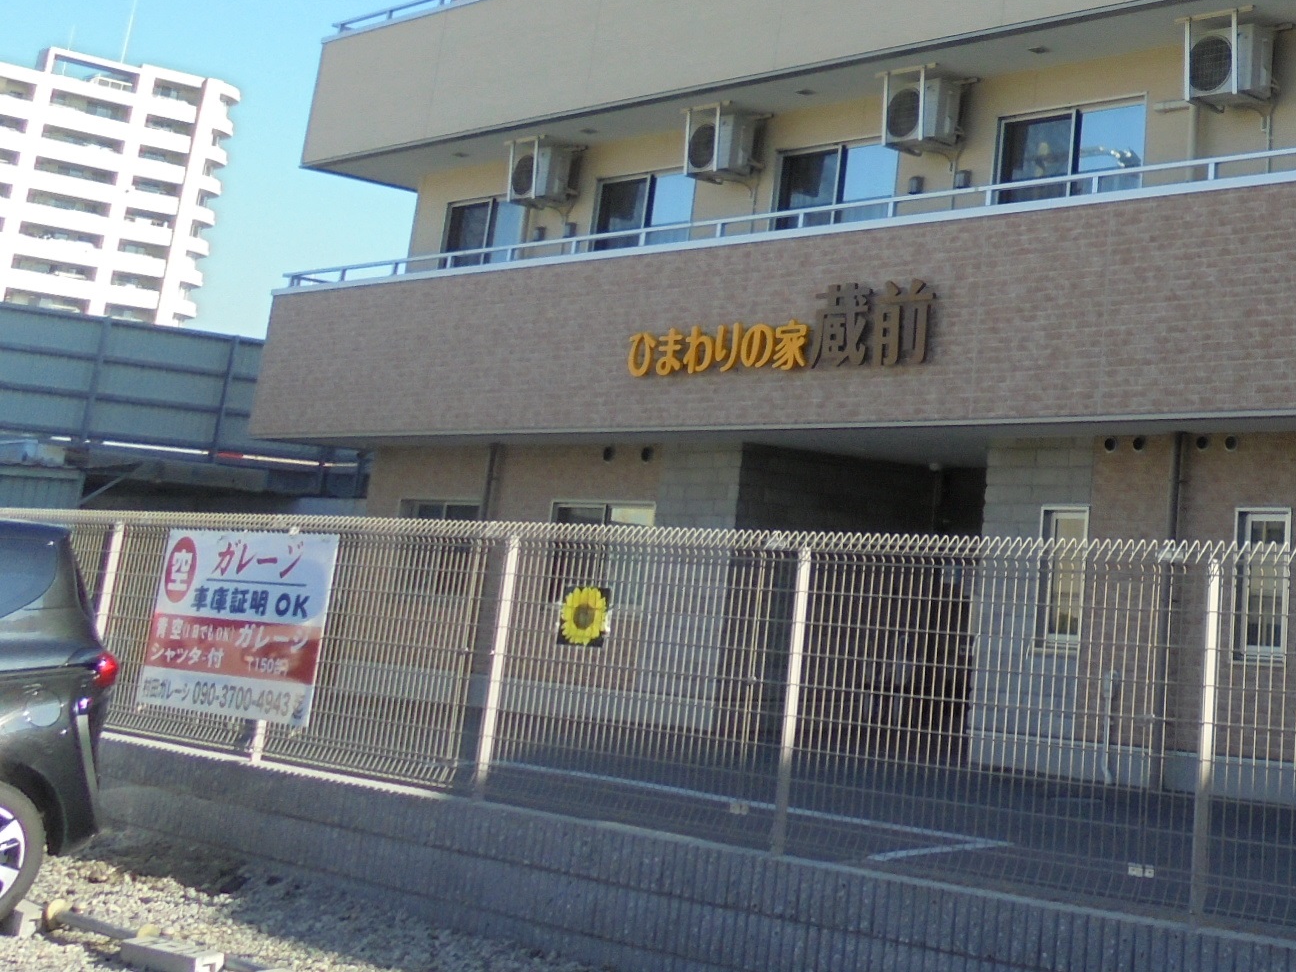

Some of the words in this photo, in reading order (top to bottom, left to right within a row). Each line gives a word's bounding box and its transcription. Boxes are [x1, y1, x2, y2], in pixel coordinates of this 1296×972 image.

[627, 319, 809, 377] ひまわりの家
[811, 278, 937, 369] 蔵前
[167, 549, 193, 592] 空
[211, 539, 304, 579] ガレージ
[191, 585, 270, 617] 車庫証明
[275, 592, 310, 619] OK
